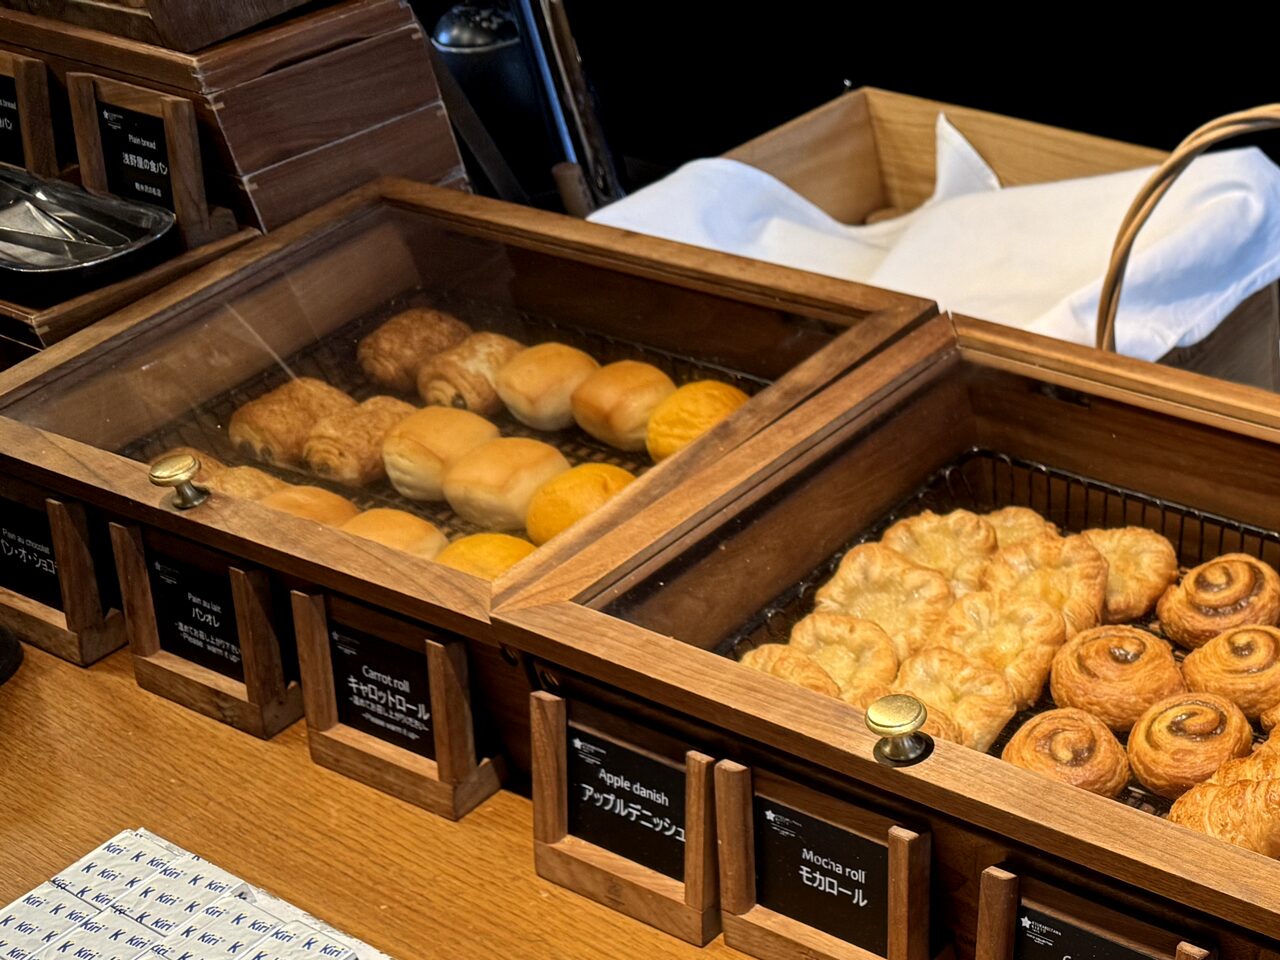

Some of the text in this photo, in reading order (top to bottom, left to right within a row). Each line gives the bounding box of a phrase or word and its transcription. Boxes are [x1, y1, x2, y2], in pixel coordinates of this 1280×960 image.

[25, 539, 50, 554] chocolat
[187, 592, 202, 604] Pain
[211, 601, 222, 613] lait
[192, 607, 220, 627] パンオレ
[361, 665, 410, 693] Carrot roll
[347, 674, 430, 720] キャロットロール
[599, 768, 669, 807] Apple danish
[580, 783, 686, 842] アップルデニッシュ
[103, 842, 126, 856] Kiri
[146, 857, 170, 869] Kiri
[802, 848, 866, 884] Mocha roll
[97, 868, 122, 881] Kiri
[205, 880, 229, 893] Kiri
[799, 865, 868, 907] モカロール
[23, 894, 46, 907] Kiri
[91, 893, 115, 905] Kiri
[14, 922, 39, 934] Kiri
[80, 919, 105, 932] Kiri
[151, 918, 175, 931] Kiri
[125, 935, 151, 948] Kiri
[271, 930, 296, 942] Kiri
[74, 947, 99, 960] Kiri
[319, 944, 344, 957] Kiri
